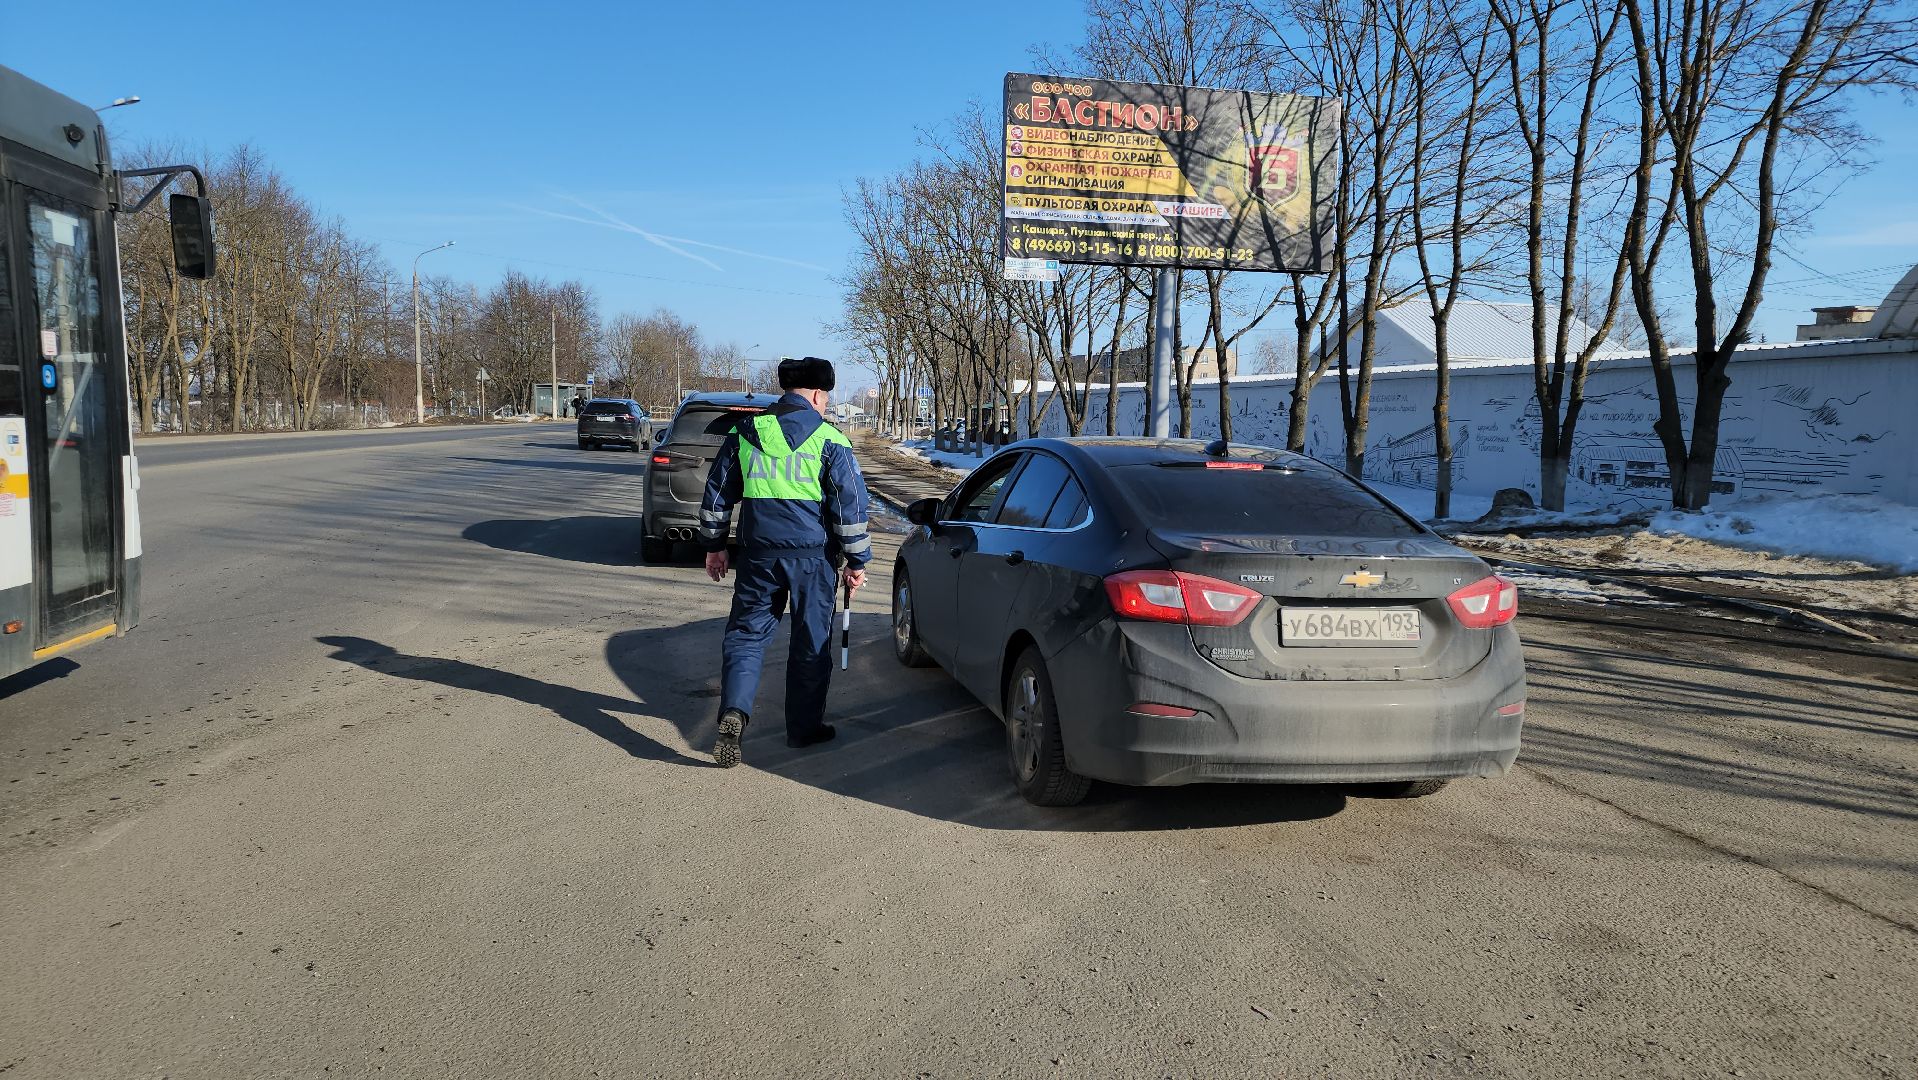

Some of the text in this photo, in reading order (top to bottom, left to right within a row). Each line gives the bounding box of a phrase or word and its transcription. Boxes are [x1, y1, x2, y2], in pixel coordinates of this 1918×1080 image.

[1014, 96, 1198, 131] «БАСТИОН»
[1027, 128, 1156, 146] ВИДЕОНАБЛЮДЕНИЕ
[1026, 145, 1162, 164] ФИЗИЧЕСКАЯ ОХРАНА
[1025, 161, 1172, 180] ОХРАННАЯ, ПОЖАРНАЯ
[1025, 175, 1125, 190] СИГНАЛИЗАЦИЯ
[1025, 197, 1153, 214] ПУЛЬТОВАЯ ОХРАНА
[1172, 205, 1223, 217] КАШИРЕ
[1023, 224, 1067, 236] Кашира,
[1071, 226, 1135, 239] Пушкинский
[1012, 238, 1254, 261] 8 (49669) 3-15-16 8 (800) 700-51-23
[747, 449, 815, 482] ДПС
[1241, 574, 1274, 582] CRUZE
[1290, 613, 1414, 638] У684ВХ 193
[1211, 647, 1254, 656] CHRISTMAS
